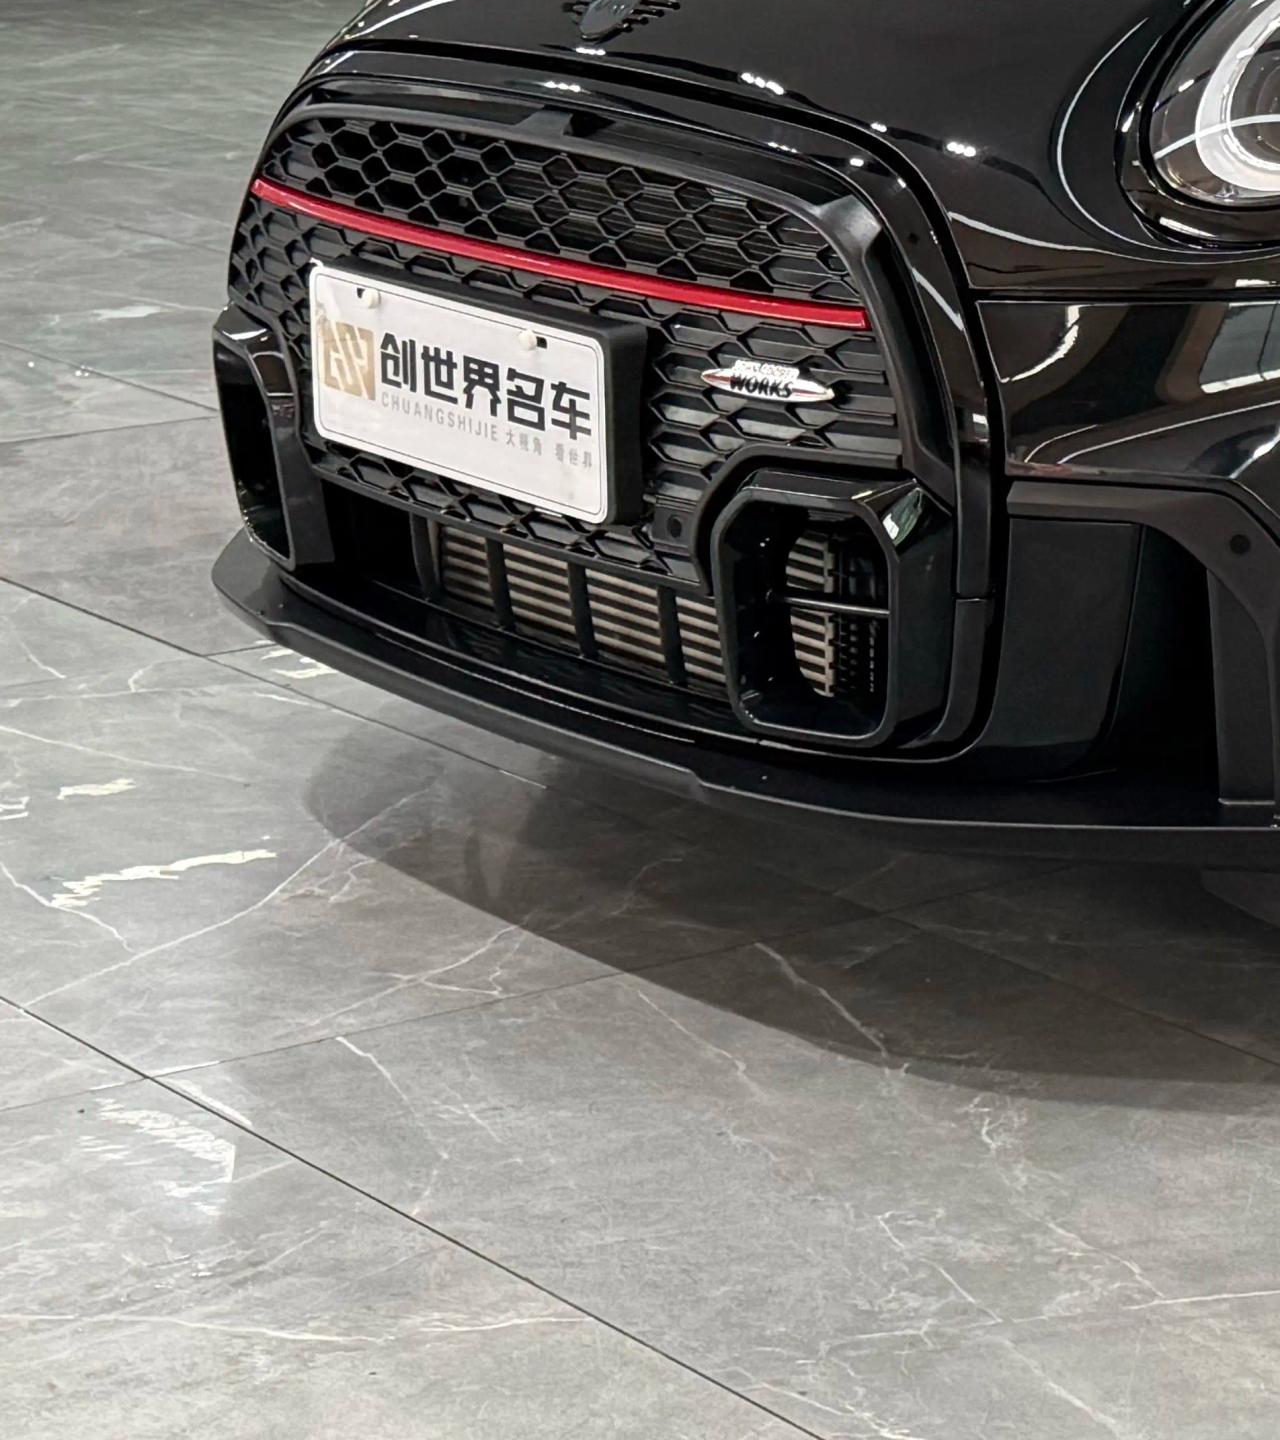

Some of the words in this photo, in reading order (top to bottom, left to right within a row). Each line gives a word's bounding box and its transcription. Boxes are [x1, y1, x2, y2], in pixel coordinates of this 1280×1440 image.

[379, 331, 592, 441] 创世界名车
[729, 372, 793, 399] WORKS
[380, 390, 498, 442] CHUANGSHIJIE
